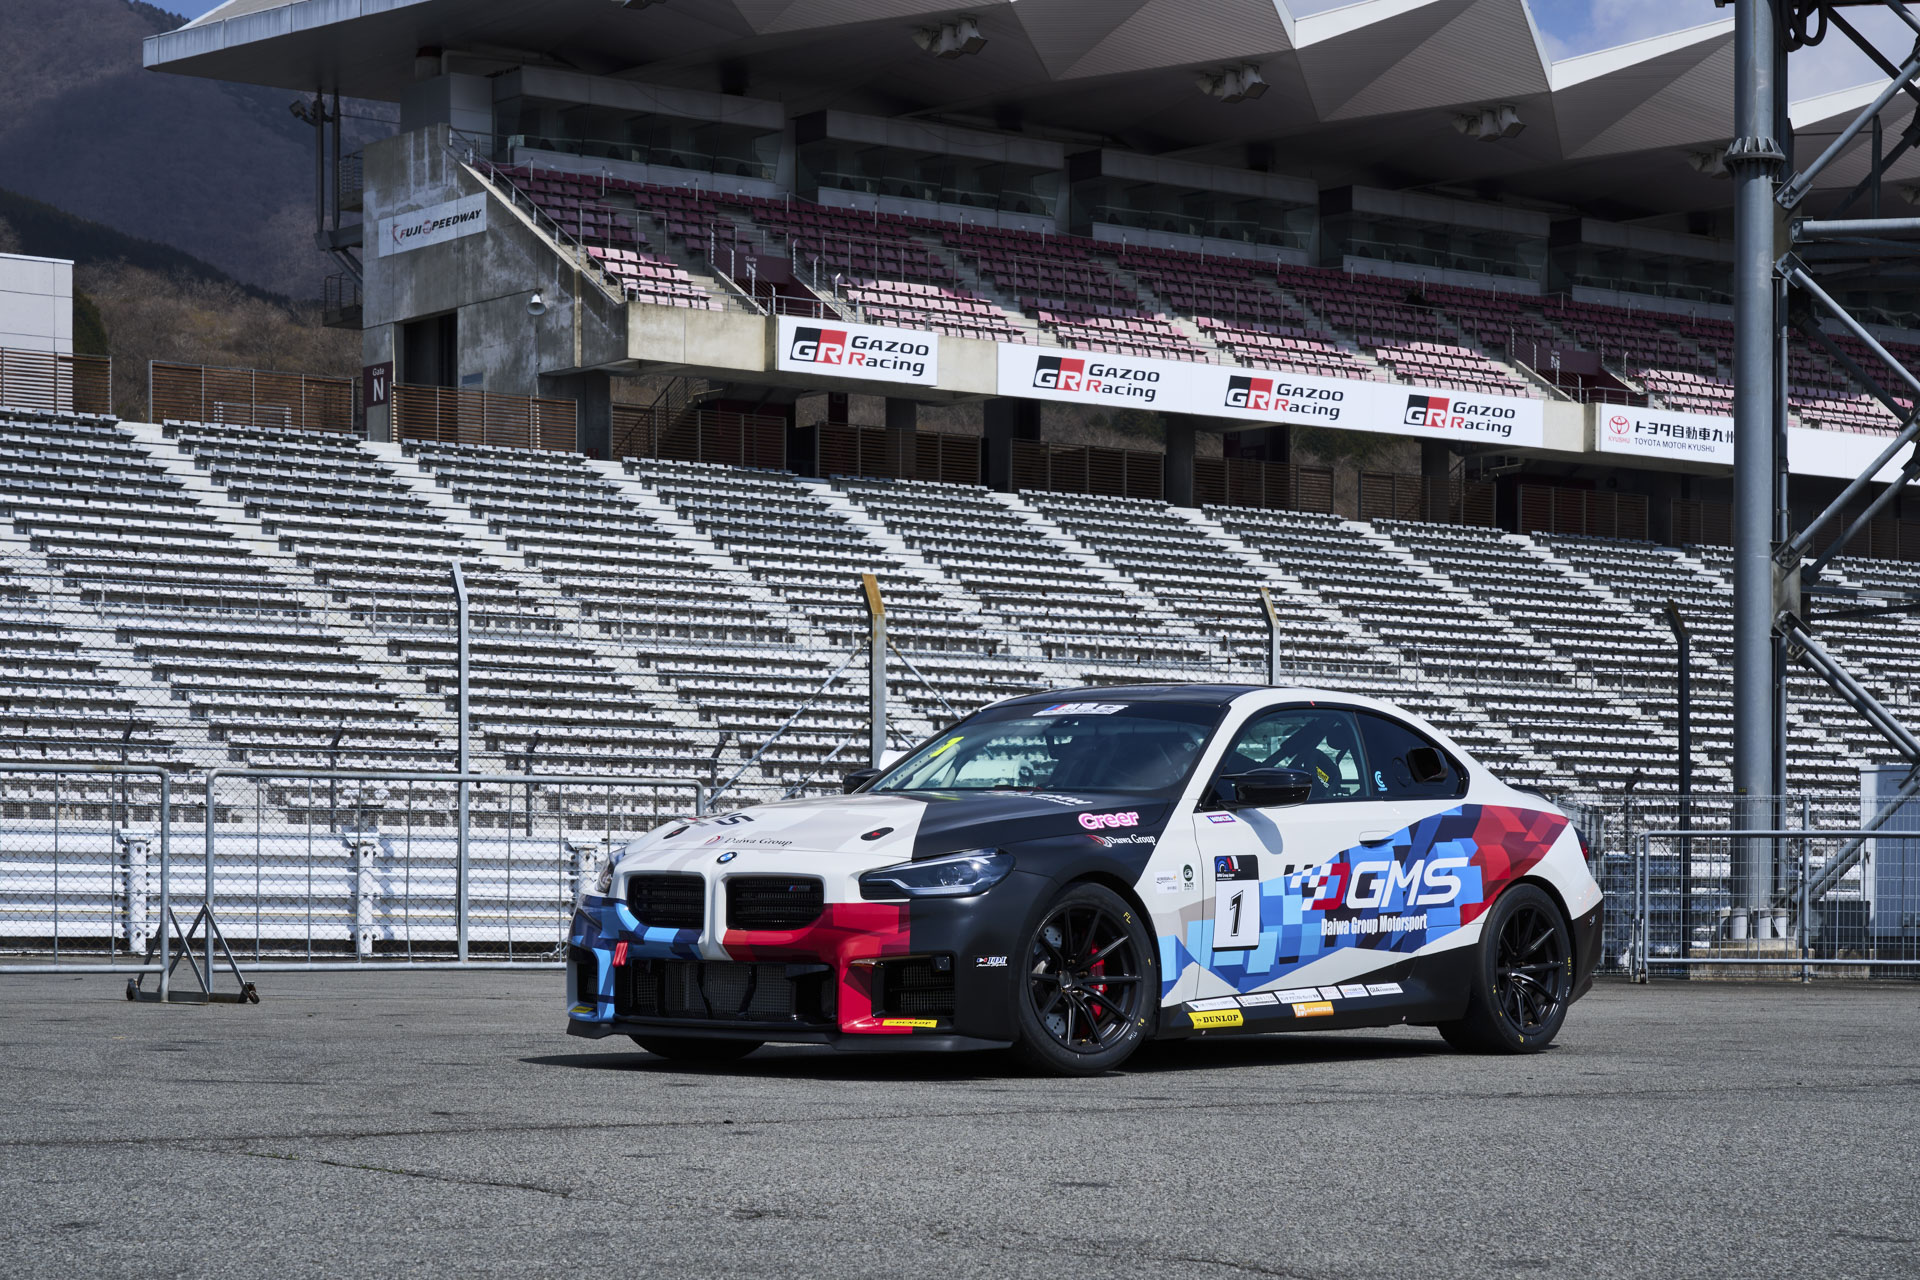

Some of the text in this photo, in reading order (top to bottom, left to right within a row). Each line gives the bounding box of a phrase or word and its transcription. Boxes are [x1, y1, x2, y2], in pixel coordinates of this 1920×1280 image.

[400, 225, 422, 240] FUJI
[791, 340, 843, 364] GR
[851, 335, 929, 356] GAZOO
[372, 368, 385, 376] Gate
[848, 352, 925, 377] Racing
[1088, 363, 1160, 383] GAZOO
[373, 377, 384, 402] N
[1034, 368, 1081, 391] GR
[1085, 379, 1157, 403] Racing
[1226, 388, 1270, 410] GR
[1276, 383, 1344, 402] GAZOO
[1274, 399, 1340, 421] Racing
[1405, 406, 1447, 428] GR
[1452, 401, 1516, 419] GAZOO
[1450, 416, 1512, 438] Racing
[1634, 437, 1716, 453] TOYOTA MOTOR KYUSHU
[1078, 811, 1139, 830] Creer
[724, 837, 793, 847] Daiwa Group
[1106, 833, 1157, 846] Daiwa Group
[1229, 889, 1244, 937] 1
[1320, 913, 1428, 936] Daiwa Group Motorsport
[1203, 1014, 1239, 1023] DUNLOP
